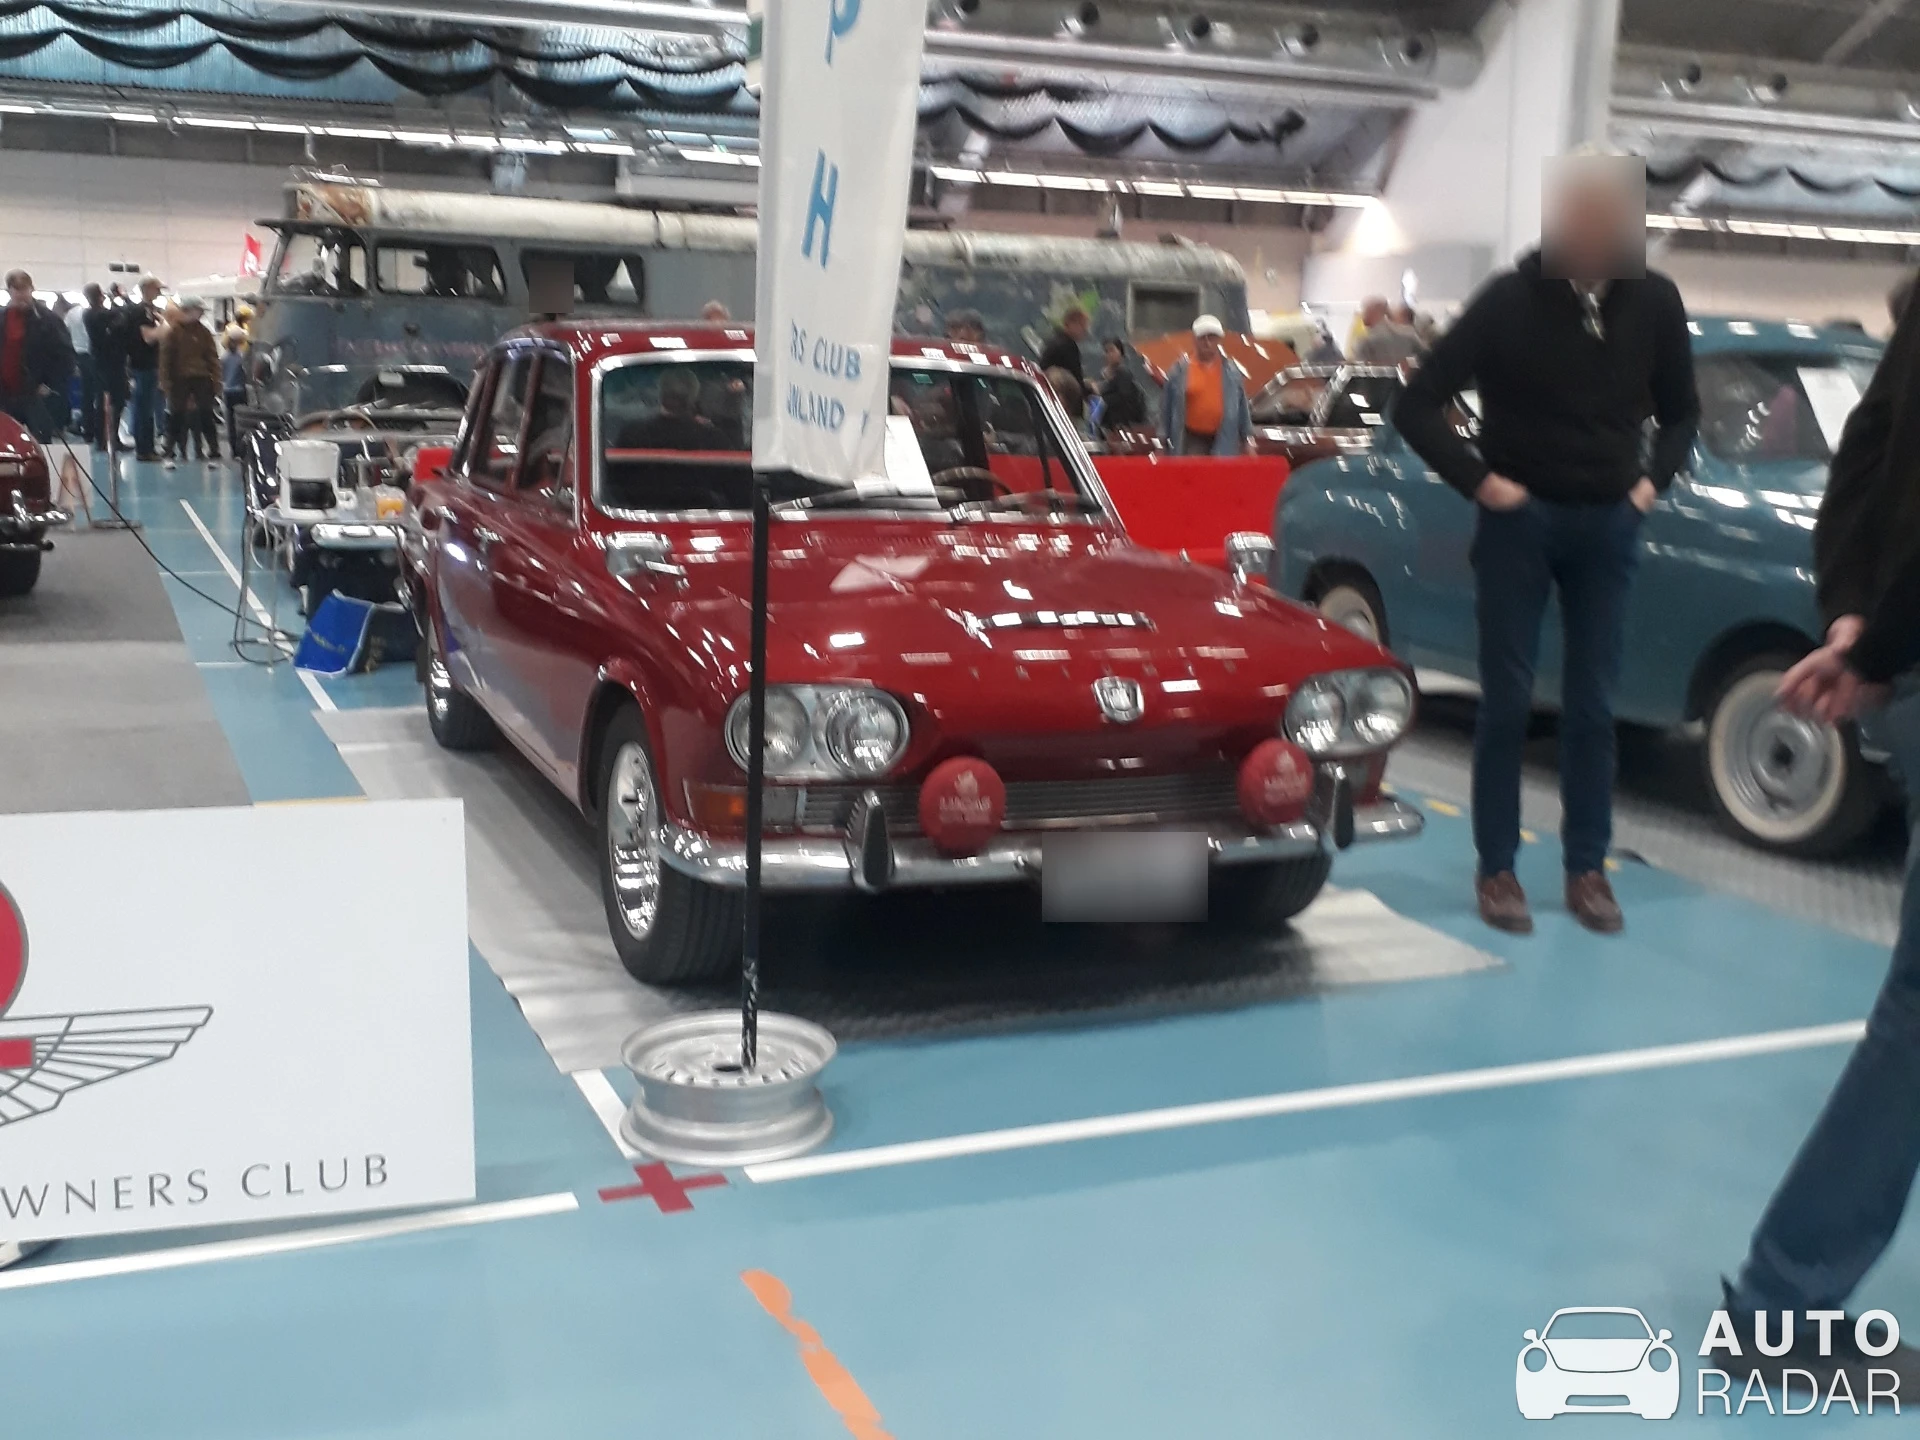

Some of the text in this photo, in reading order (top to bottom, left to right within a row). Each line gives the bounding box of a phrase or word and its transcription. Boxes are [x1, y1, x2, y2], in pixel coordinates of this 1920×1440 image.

[812, 336, 861, 380] CLUB
[0, 1153, 388, 1219] WNERS CLUB
